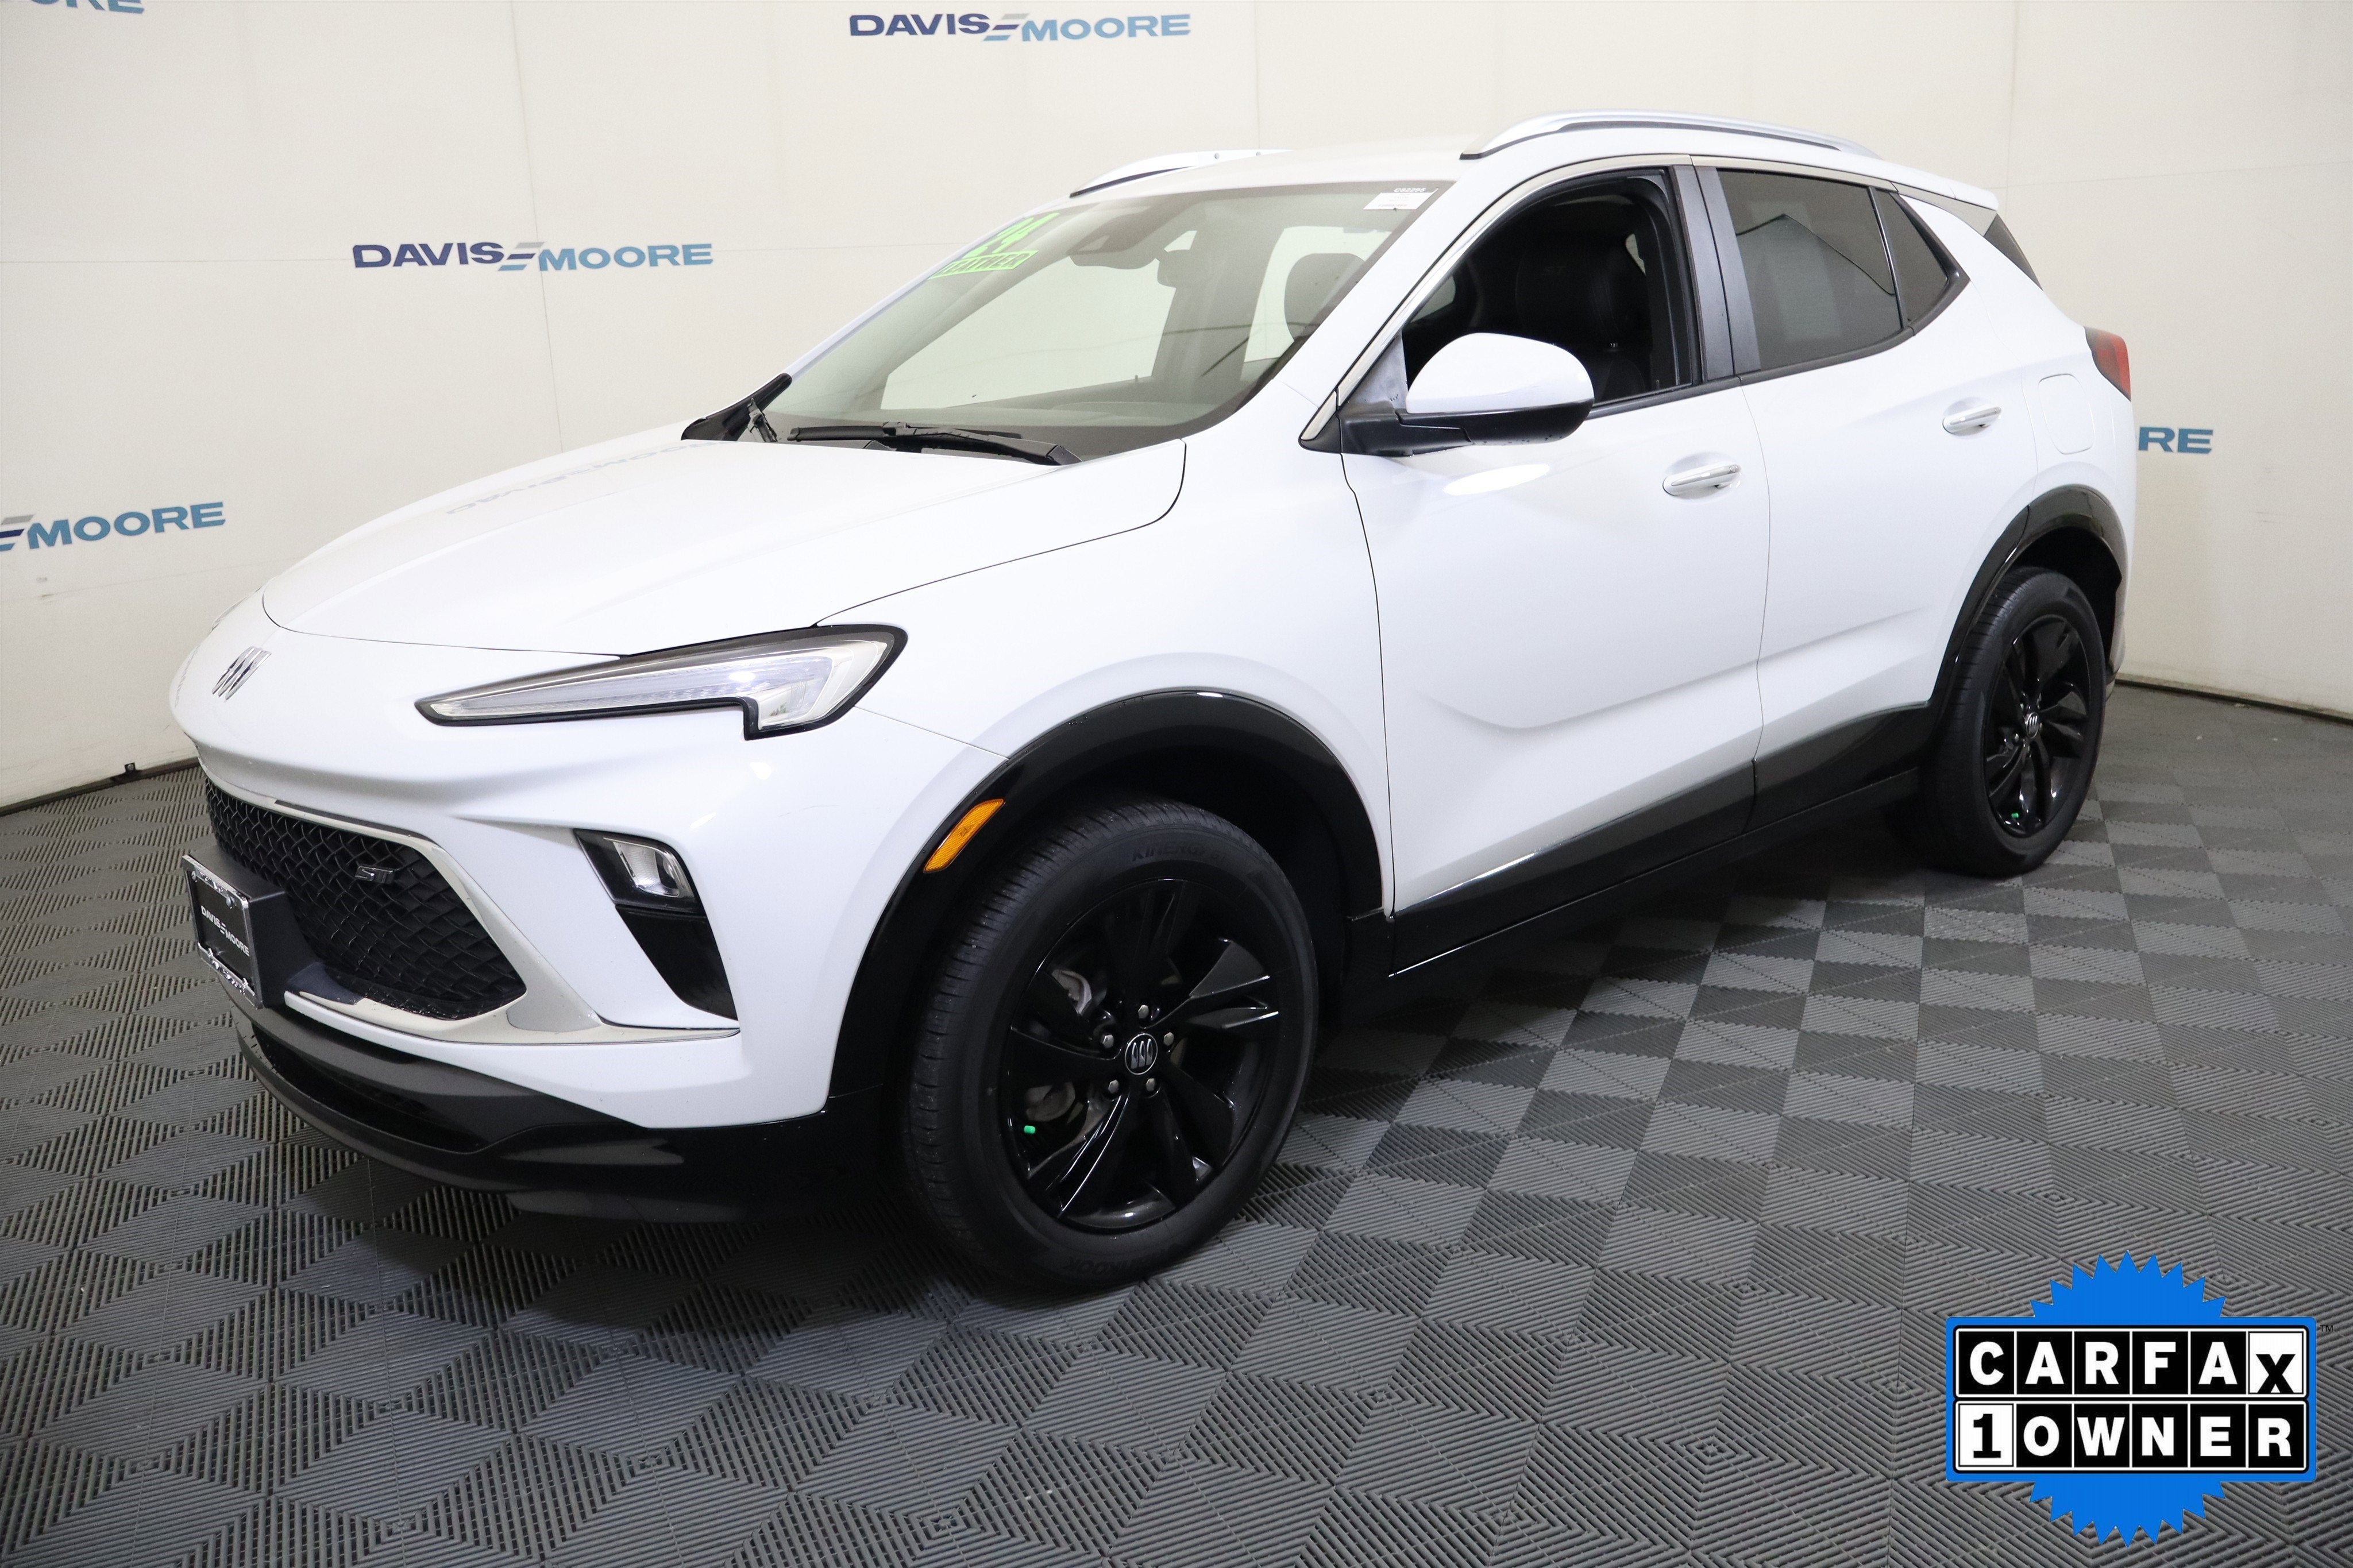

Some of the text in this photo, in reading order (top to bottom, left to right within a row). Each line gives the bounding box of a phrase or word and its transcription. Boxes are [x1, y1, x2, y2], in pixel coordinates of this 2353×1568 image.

[849, 13, 1191, 42] DAVIS MOORE
[352, 242, 713, 272] DAVIS MOORE
[26, 501, 226, 550] MOORE
[355, 866, 394, 883] ST
[201, 905, 221, 928] DAVIS
[225, 929, 250, 957] MOORE
